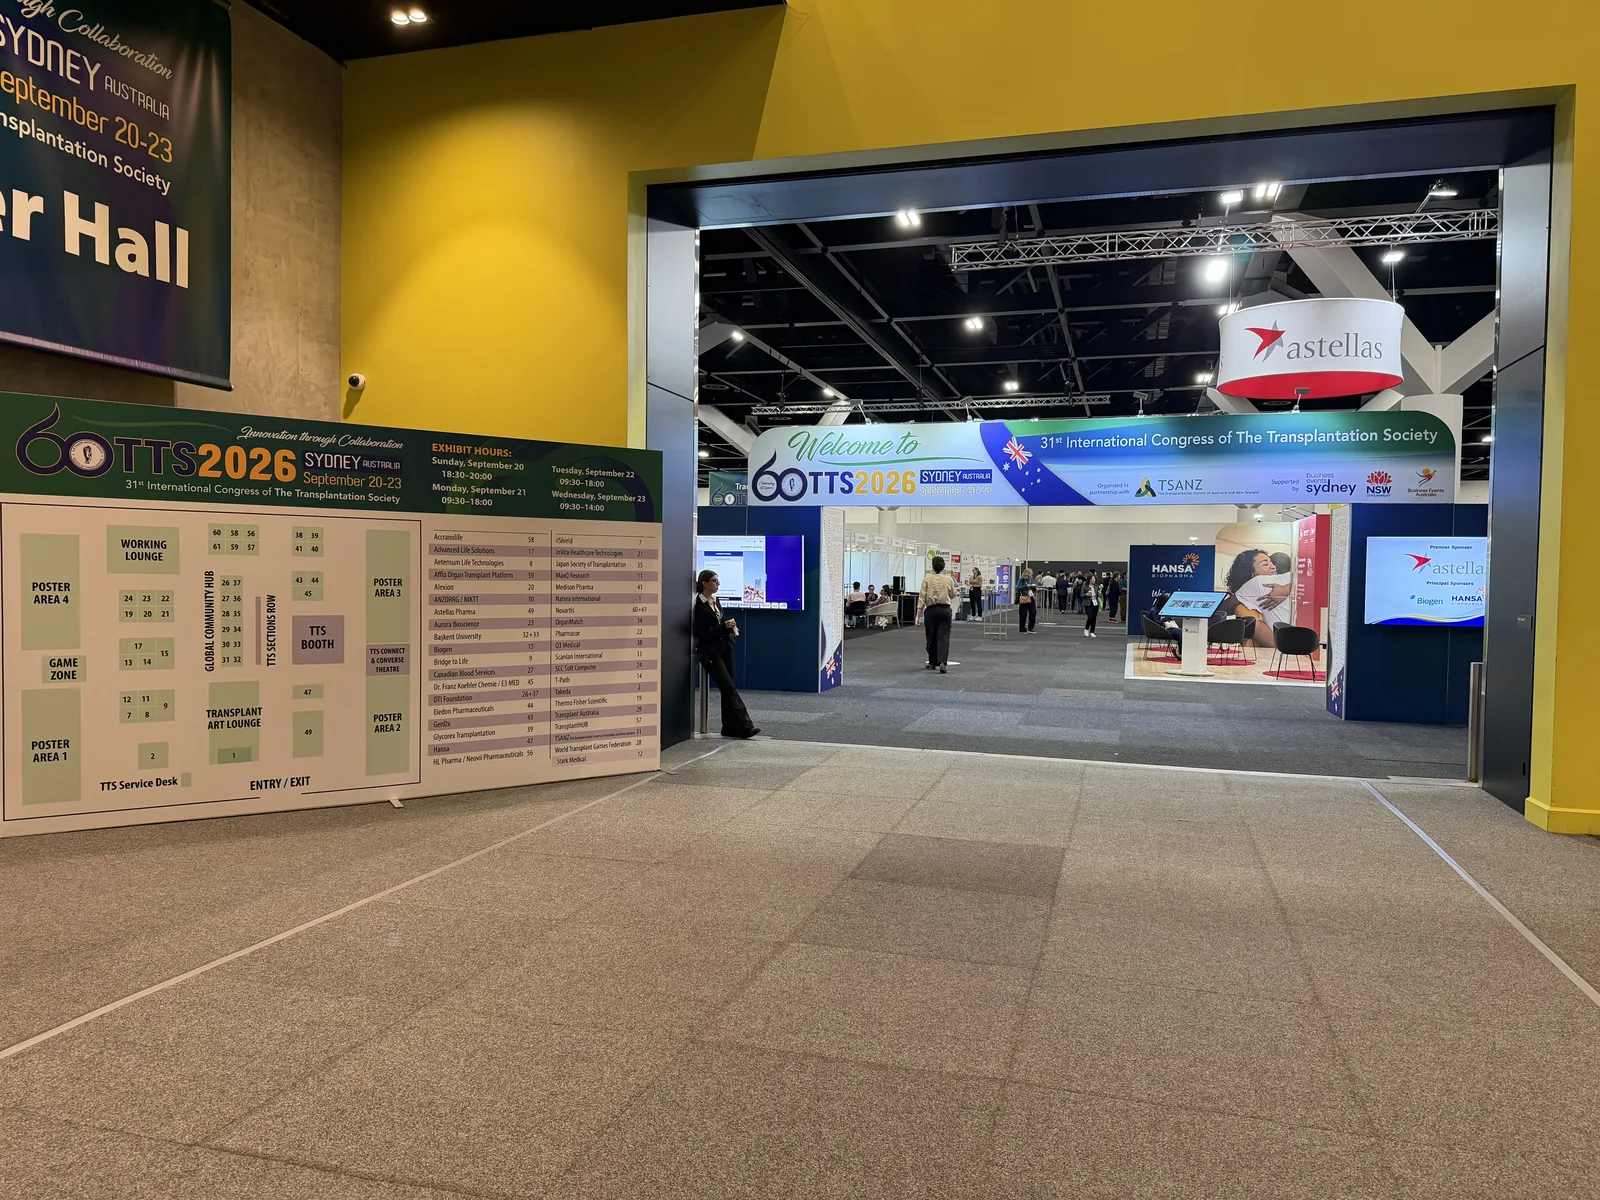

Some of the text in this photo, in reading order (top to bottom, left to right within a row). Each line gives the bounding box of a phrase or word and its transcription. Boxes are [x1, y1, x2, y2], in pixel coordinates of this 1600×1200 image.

[58, 9, 173, 80] Collaboration
[0, 13, 170, 120] SYDNEY AUSTRALIA
[115, 116, 173, 163] 20-23
[113, 156, 171, 196] Society
[64, 190, 189, 288] Hall
[1287, 333, 1382, 359] astellas
[237, 426, 404, 449] Innovation through Collaboration
[1040, 428, 1438, 449] 31st International Congress of The Transplantation Society
[432, 443, 512, 458] EXHIBIT HOURS:
[788, 431, 921, 462] Welcome to
[304, 452, 400, 470] SYDNEY AUSTRALIA
[432, 457, 524, 471] Sunday, September 20
[551, 466, 584, 475] Tuesday,
[585, 468, 625, 478] September
[922, 470, 961, 482] SYDNEY
[303, 472, 401, 489] September 20-23
[1158, 479, 1203, 491] TSANZ
[126, 480, 400, 504] 31st International Congress of The Transplantation Society
[432, 483, 469, 495] Monday,
[471, 486, 515, 496] September
[920, 485, 991, 496] September 20-23
[1306, 479, 1356, 496] sydney
[1366, 486, 1392, 494] NSW
[551, 490, 596, 500] Wednesday,
[597, 493, 636, 502] September
[121, 539, 167, 549] WORKING
[125, 552, 163, 561] LOUNGE
[1152, 564, 1193, 573] HANSA
[1432, 561, 1484, 575] astella
[32, 582, 70, 592] POSTER
[373, 578, 403, 587] POSTER
[375, 589, 401, 597] AREA 3
[33, 595, 69, 604] AREA 4
[1417, 597, 1443, 606] Biogen
[204, 570, 215, 672] GLOBAL COMMUNITY HUB
[266, 594, 276, 667] TTS SECTIONS ROW
[309, 626, 326, 636] TTS
[455, 632, 481, 640] University
[301, 639, 334, 649] BOOTH
[49, 658, 78, 668] GAME
[50, 670, 77, 680] ZONE
[206, 707, 262, 718] TRANSPLANT
[373, 713, 403, 722] POSTER
[207, 718, 261, 729] ART LOUNGE
[374, 723, 401, 733] AREA 2
[31, 739, 70, 750] POSTER
[555, 745, 568, 753] World
[569, 743, 592, 752] Transplant
[33, 752, 67, 762] AREA 1
[100, 776, 178, 791] TTS Service Desk
[250, 776, 311, 791] ENTRY / EXIT
